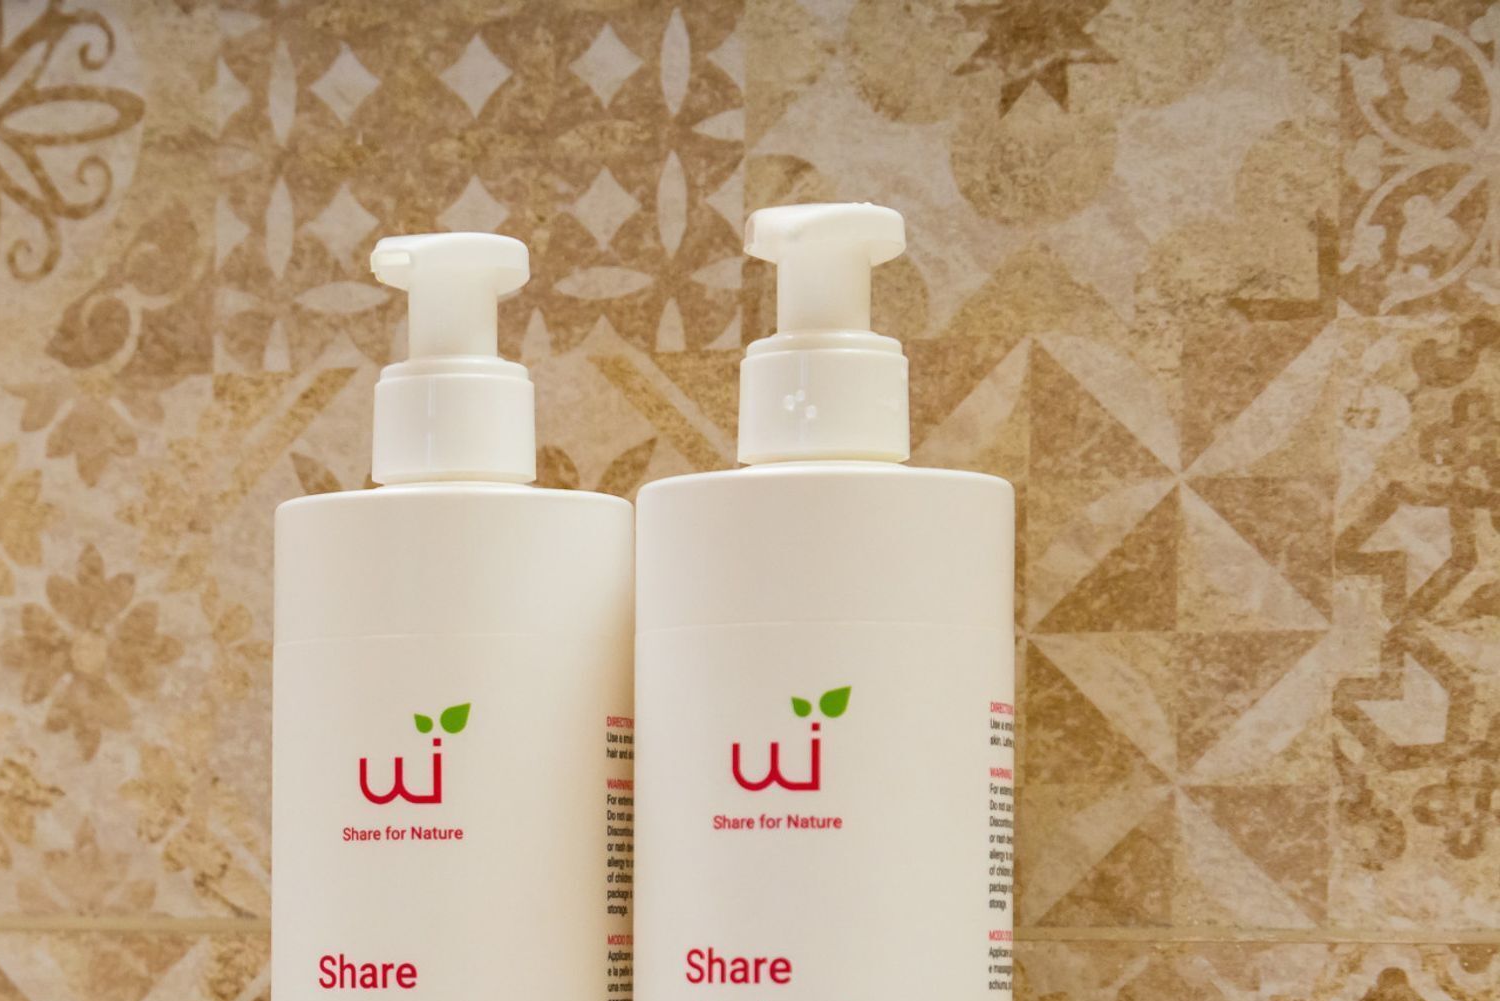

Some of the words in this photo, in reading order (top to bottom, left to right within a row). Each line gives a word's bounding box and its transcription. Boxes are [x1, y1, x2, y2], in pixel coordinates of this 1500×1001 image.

[343, 827, 381, 841] Share
[386, 826, 406, 840] for
[411, 827, 463, 840] Nature
[714, 815, 755, 830] Share
[759, 814, 782, 829] for
[787, 815, 842, 829] Nature
[319, 954, 417, 989] Share
[687, 948, 791, 984] Share
